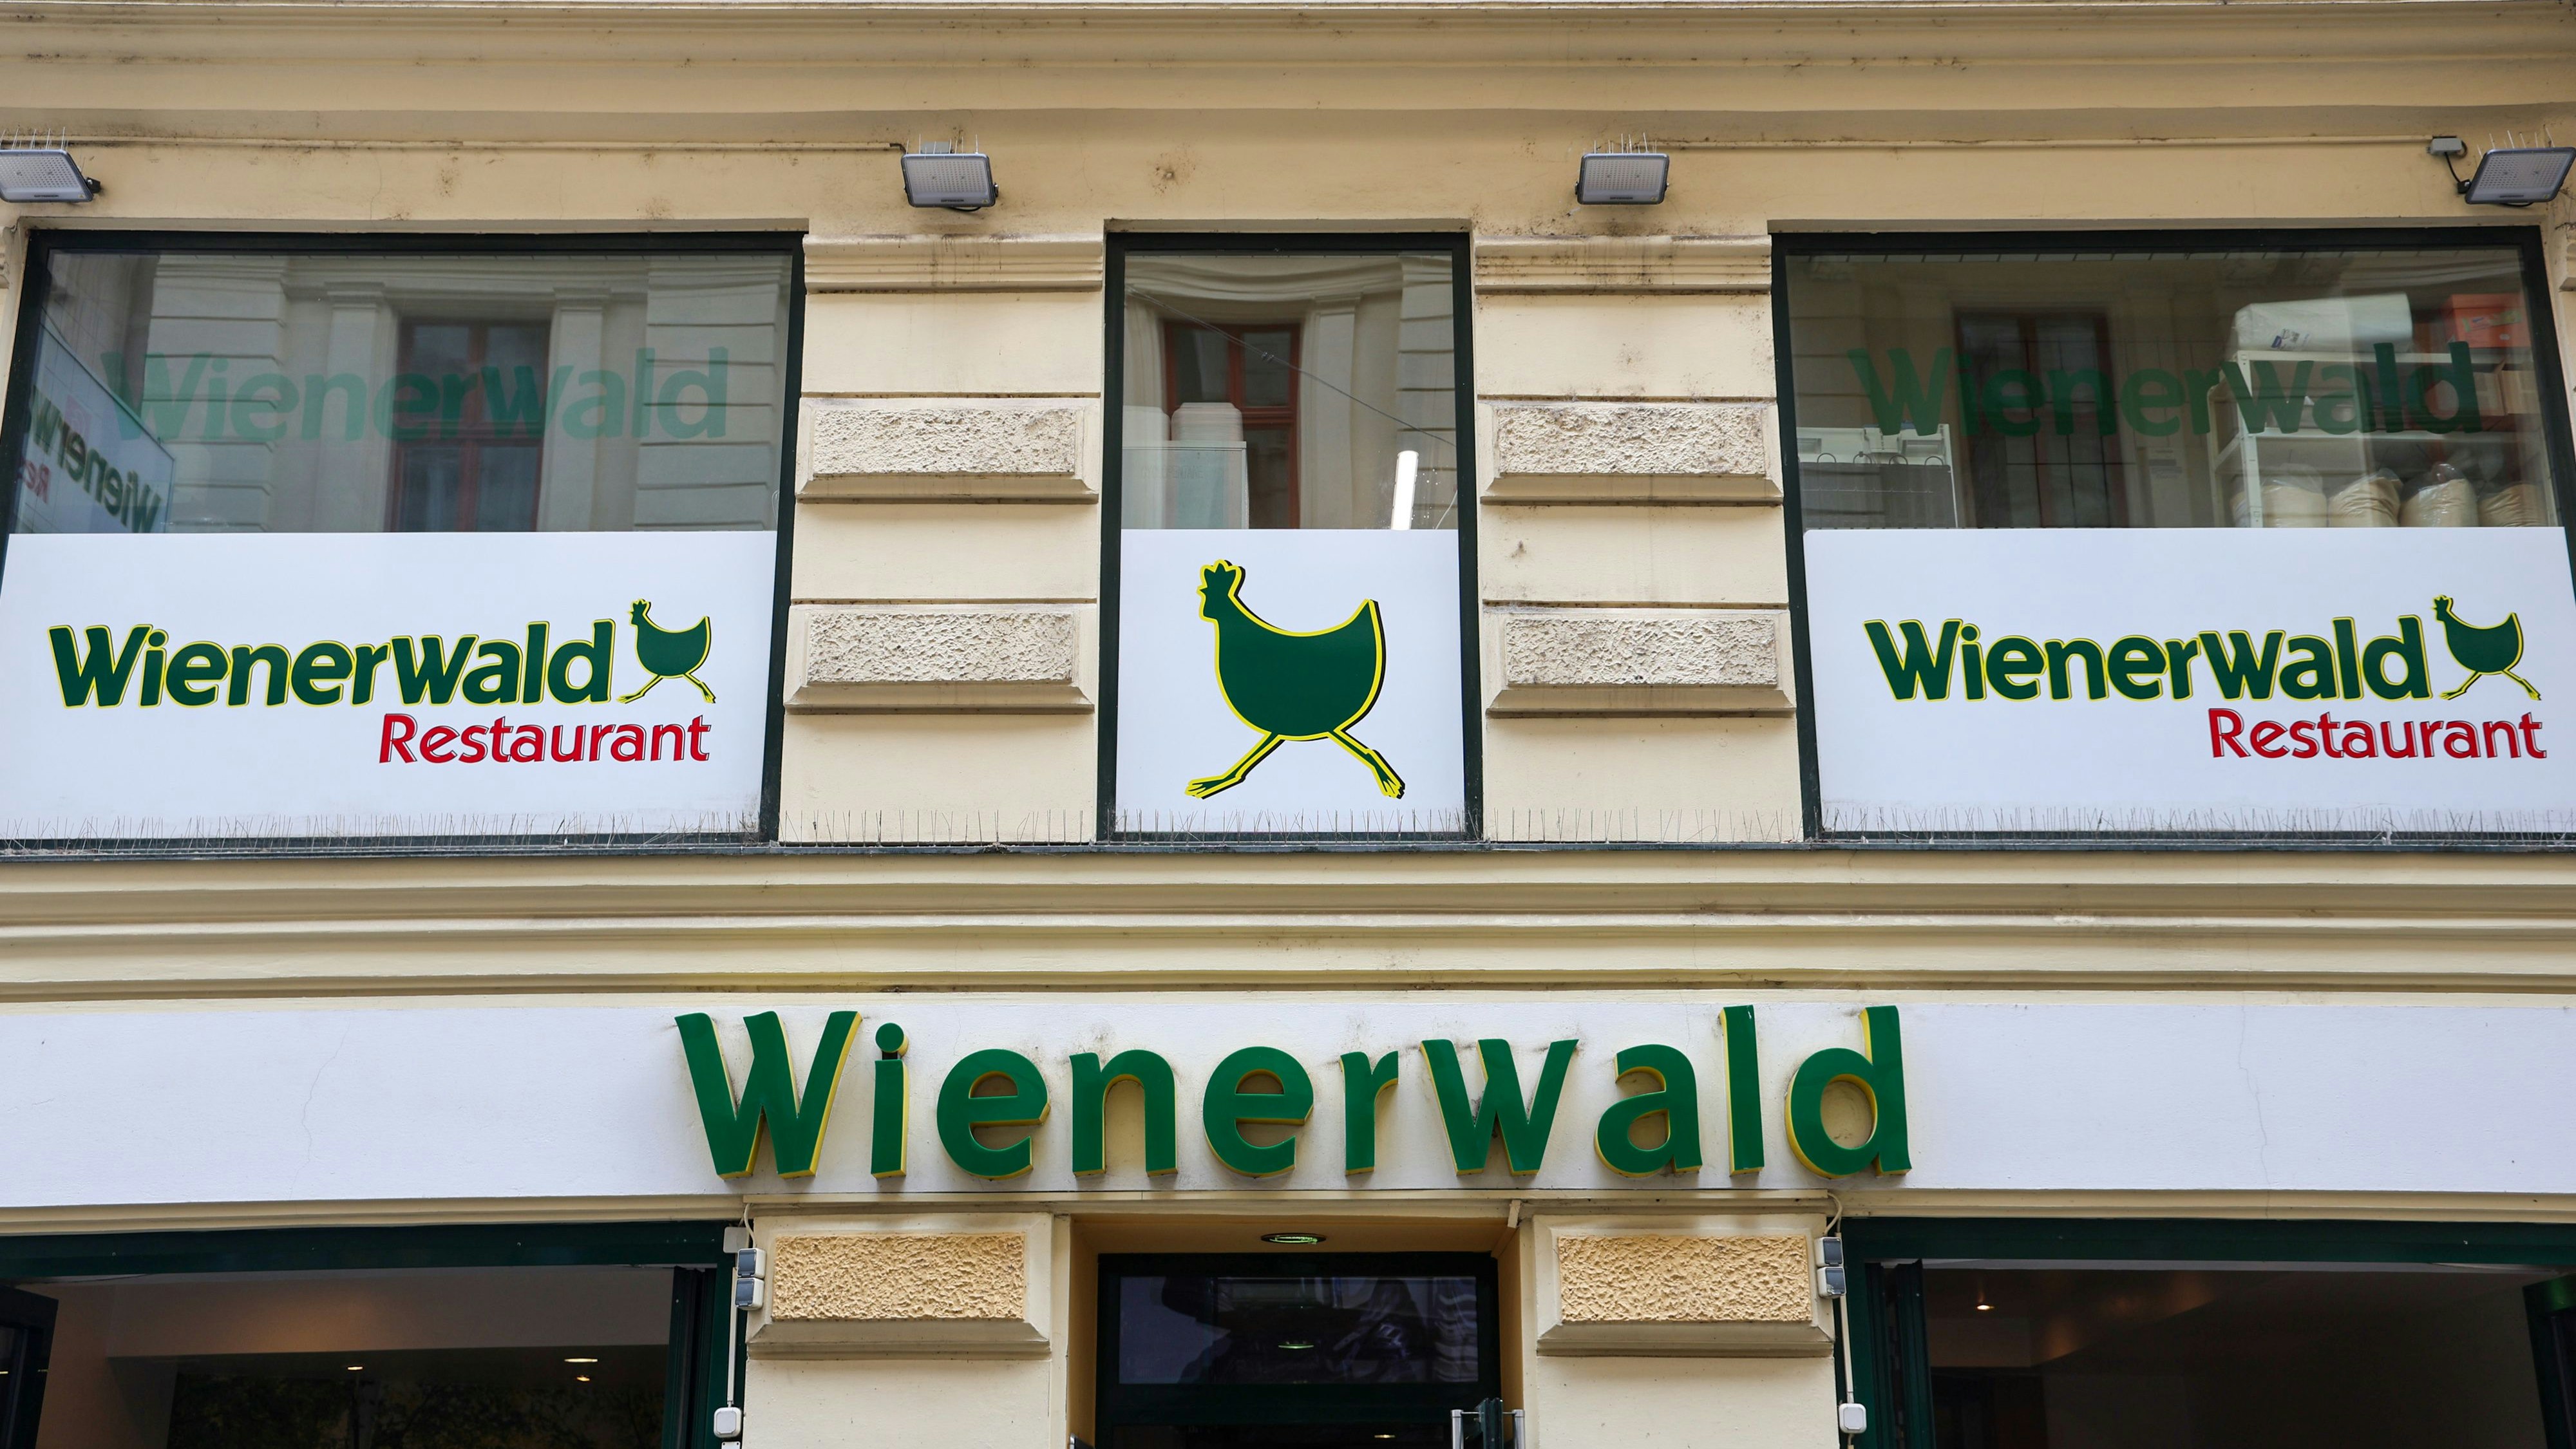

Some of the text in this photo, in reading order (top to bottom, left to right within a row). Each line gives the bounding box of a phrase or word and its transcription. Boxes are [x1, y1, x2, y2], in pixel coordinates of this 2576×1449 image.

[101, 346, 728, 441] Wienerwald
[1848, 342, 2483, 435] Wienerwald
[48, 618, 616, 708] Wienerwald
[1864, 614, 2434, 702] Wienerwald
[379, 713, 711, 764] Restaurant
[2208, 708, 2547, 759] Restaurant
[674, 1004, 1912, 1179] Wienerwald
